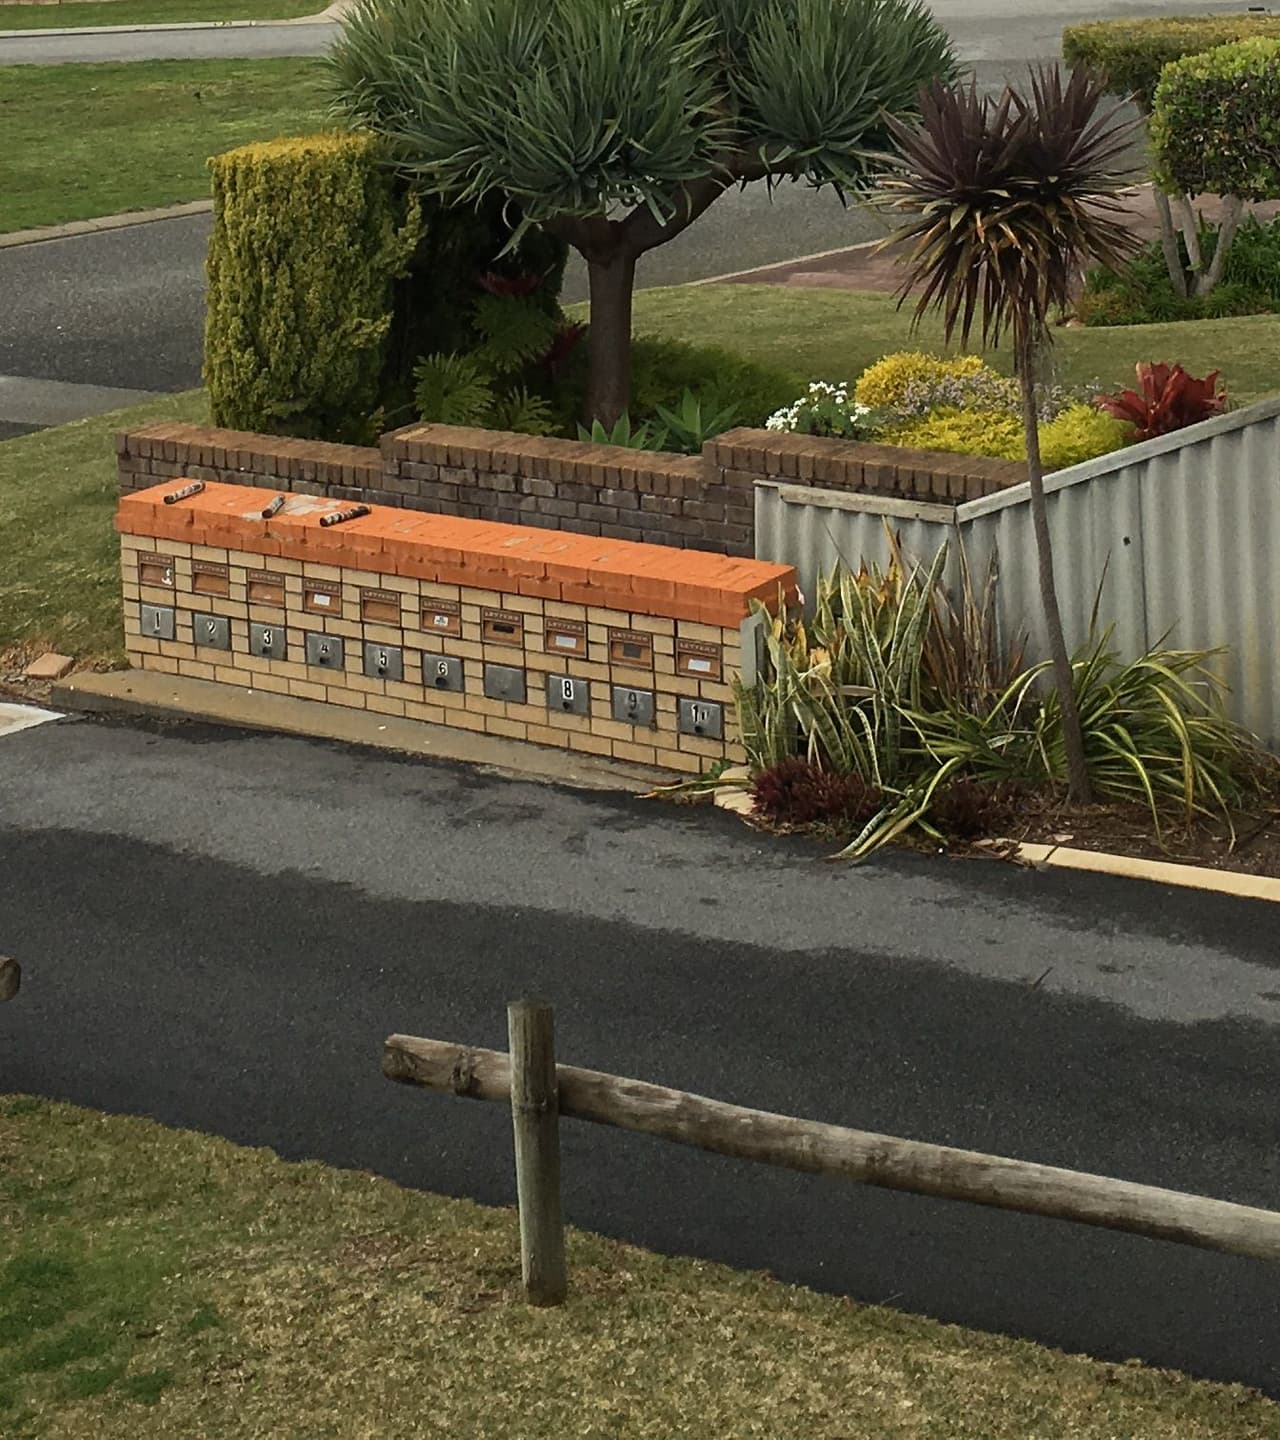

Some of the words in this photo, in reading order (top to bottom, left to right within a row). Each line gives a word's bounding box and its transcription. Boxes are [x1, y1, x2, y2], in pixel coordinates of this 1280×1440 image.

[263, 628, 272, 645] 3
[379, 650, 388, 666] 5
[438, 661, 447, 675] 6
[564, 680, 572, 698] 8
[628, 691, 637, 710] 9
